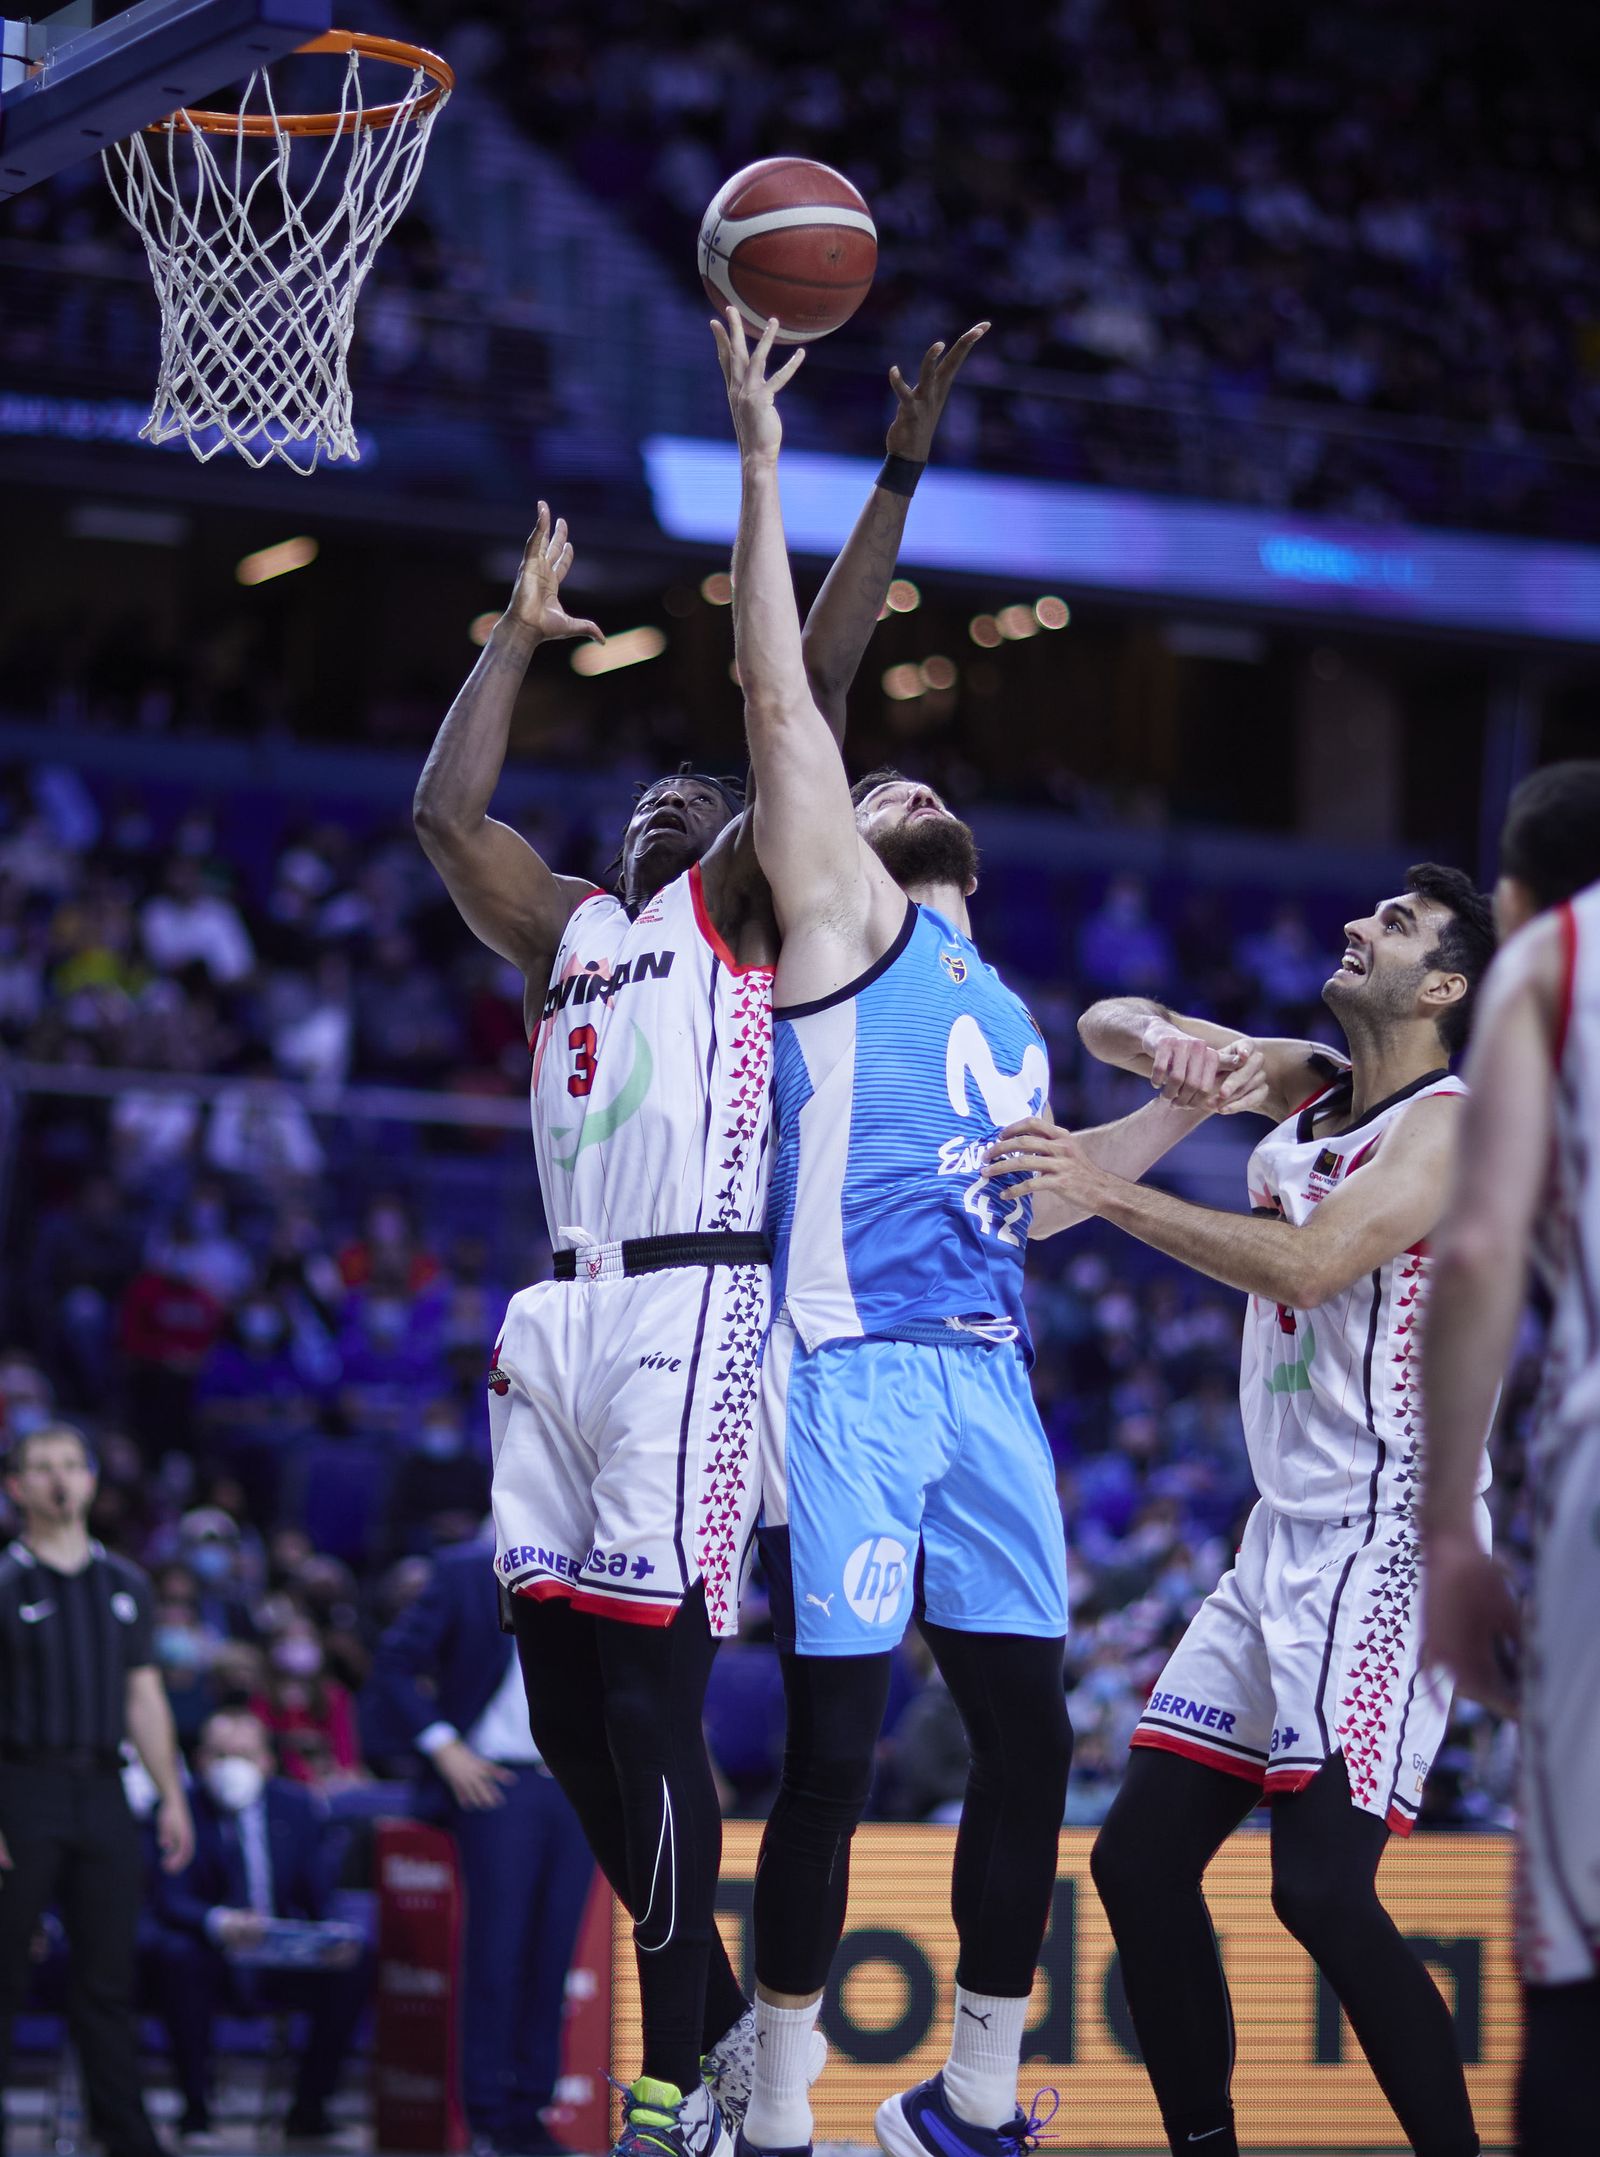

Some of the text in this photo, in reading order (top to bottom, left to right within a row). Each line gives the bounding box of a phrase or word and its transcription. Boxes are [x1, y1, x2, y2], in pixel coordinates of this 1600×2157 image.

[568, 1023, 598, 1098] 3
[963, 1176, 1024, 1248] 42
[503, 1545, 585, 1580] BERNER
[851, 1537, 904, 1624] hp
[1150, 1692, 1236, 1734] BERNER
